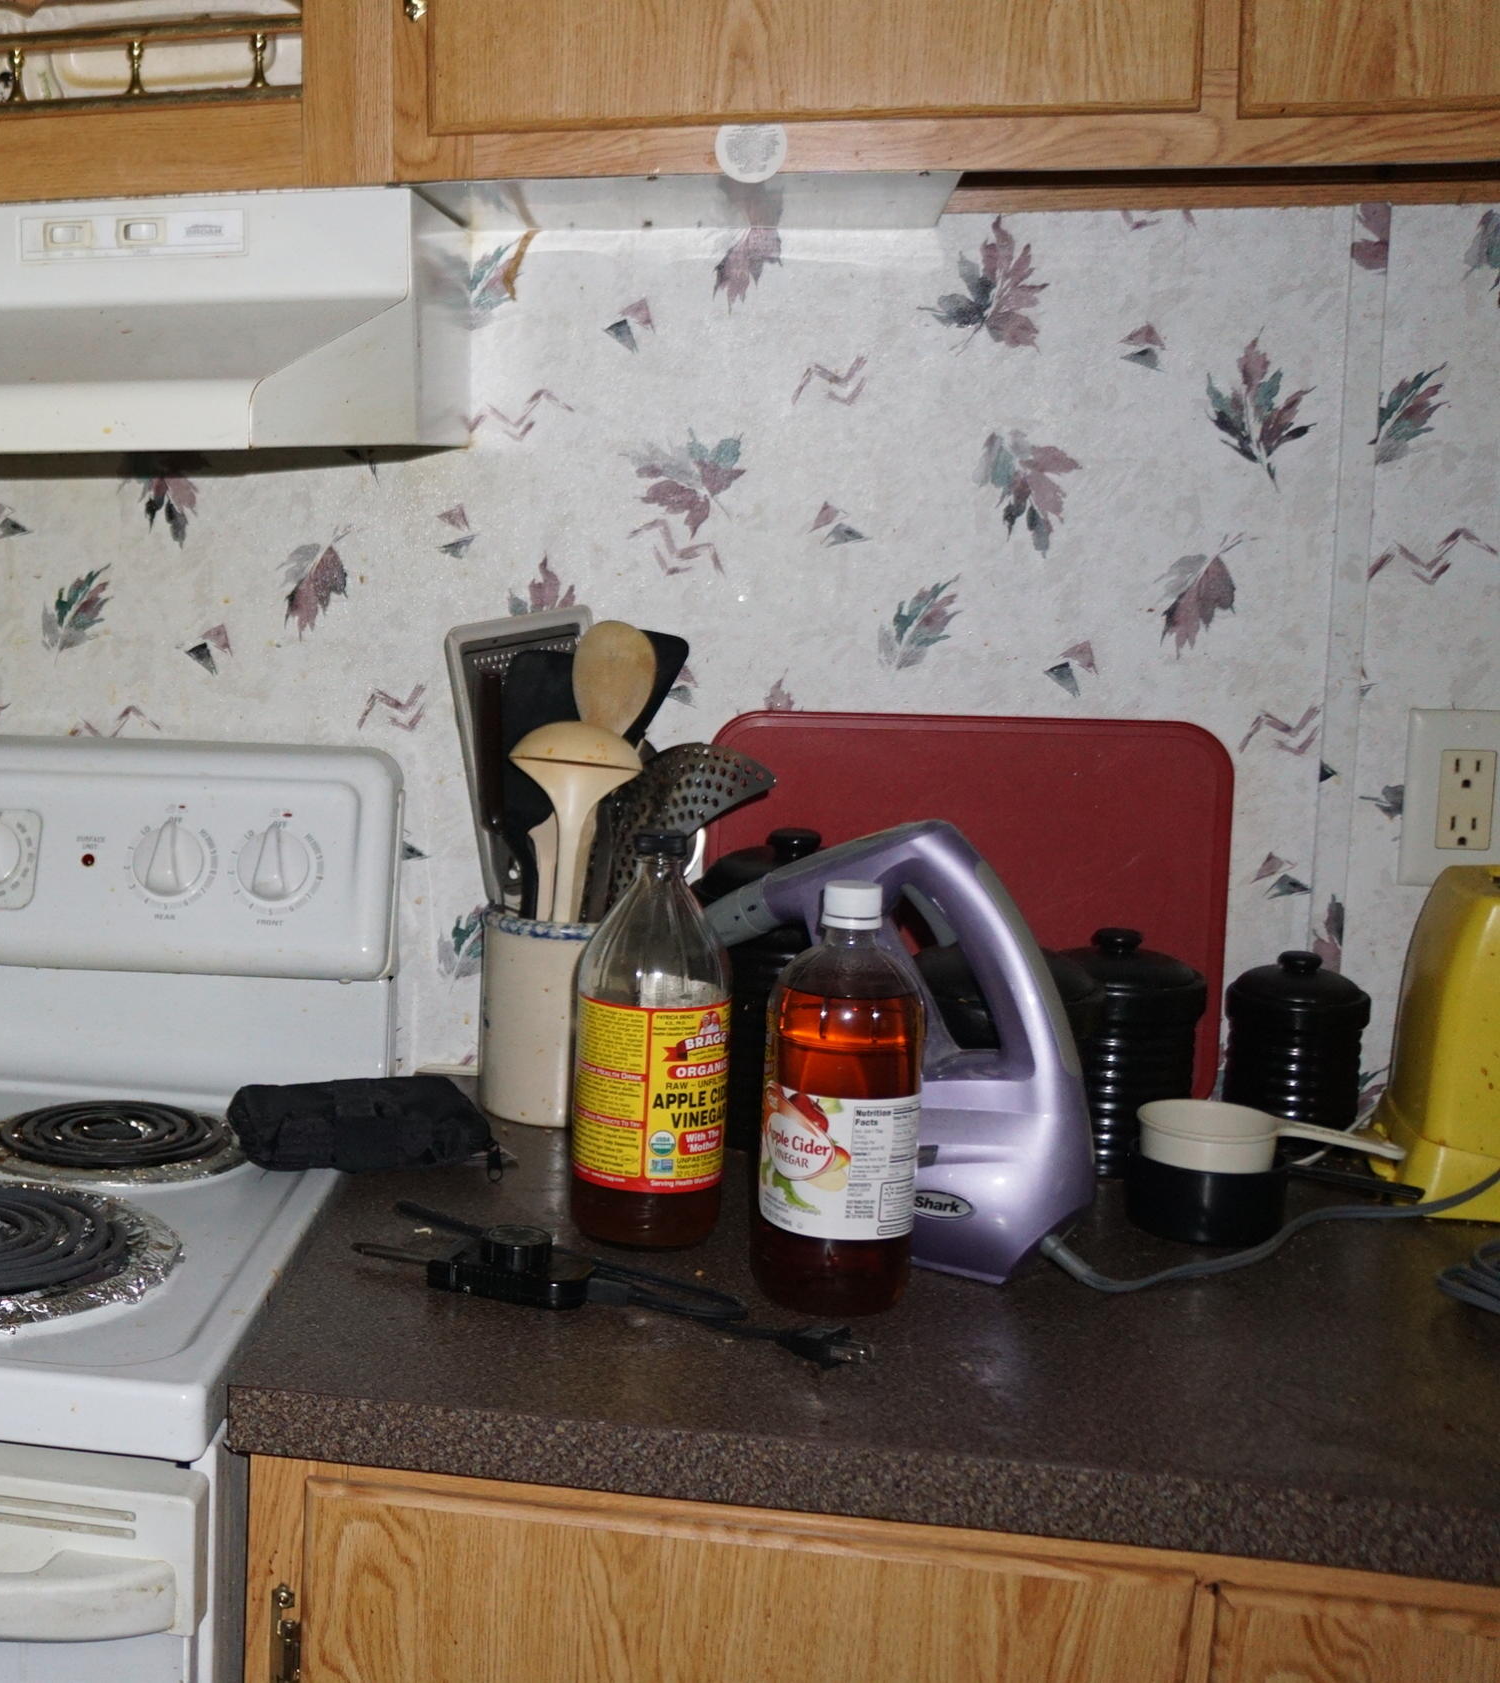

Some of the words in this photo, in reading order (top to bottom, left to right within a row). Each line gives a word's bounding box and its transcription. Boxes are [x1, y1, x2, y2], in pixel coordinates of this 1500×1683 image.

[665, 1082, 688, 1090] RAW
[652, 1090, 707, 1109] APPLE
[710, 1085, 727, 1105] CID
[855, 1109, 892, 1117] Nutrition
[855, 1118, 879, 1126] Facts
[685, 1132, 706, 1143] With
[791, 1135, 831, 1157] Cider
[914, 1195, 961, 1213] Shark
